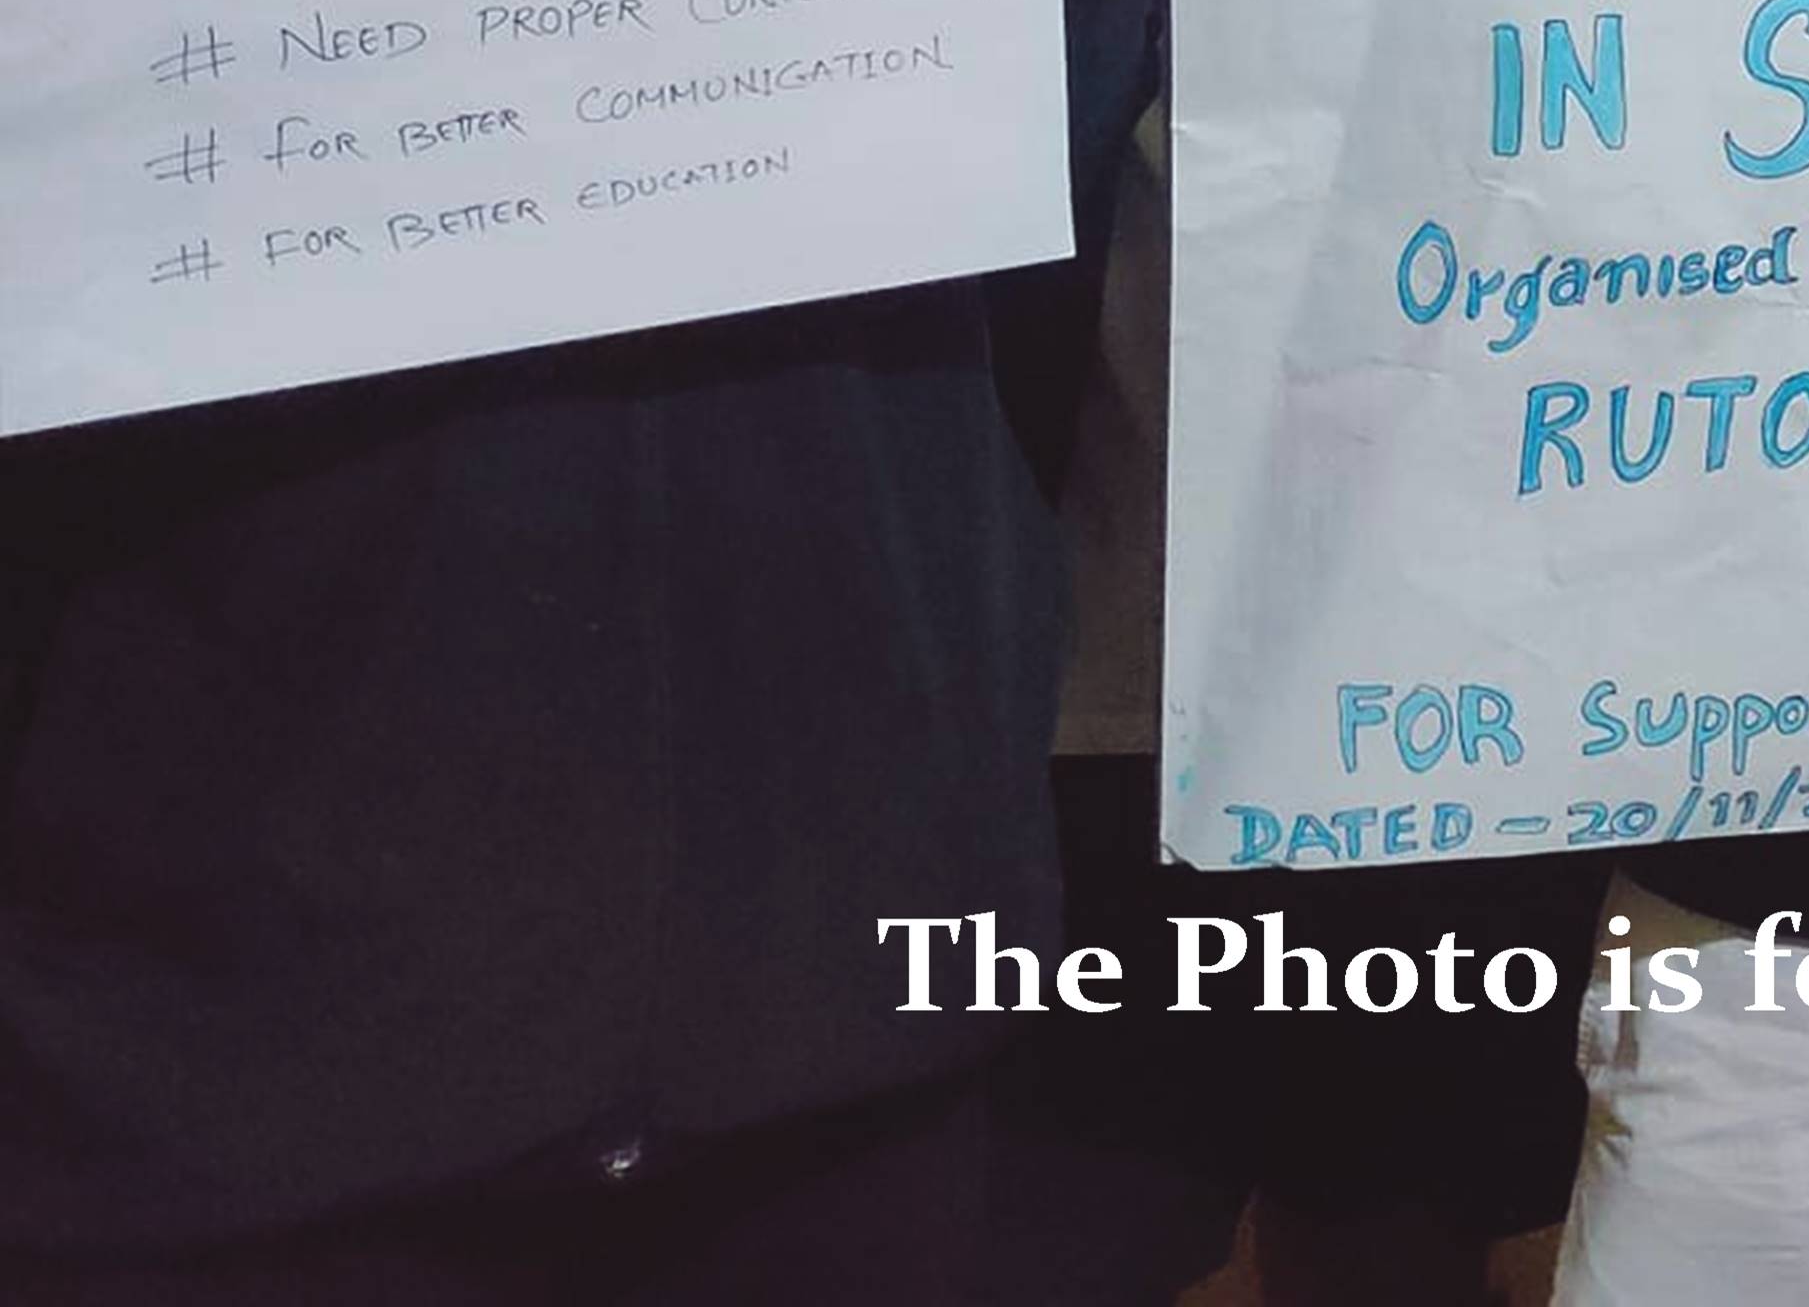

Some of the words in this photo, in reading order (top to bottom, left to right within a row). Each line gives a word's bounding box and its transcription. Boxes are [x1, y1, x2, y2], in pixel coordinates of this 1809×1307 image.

[279, 11, 428, 70] NEED
[1489, 12, 1626, 160] IN
[397, 107, 528, 158] BETTER
[264, 225, 362, 266] FOR
[386, 198, 546, 253] BETTER
[576, 146, 789, 210] EDUCATION
[1398, 222, 1798, 354] Organised
[1336, 682, 1525, 773] FOR
